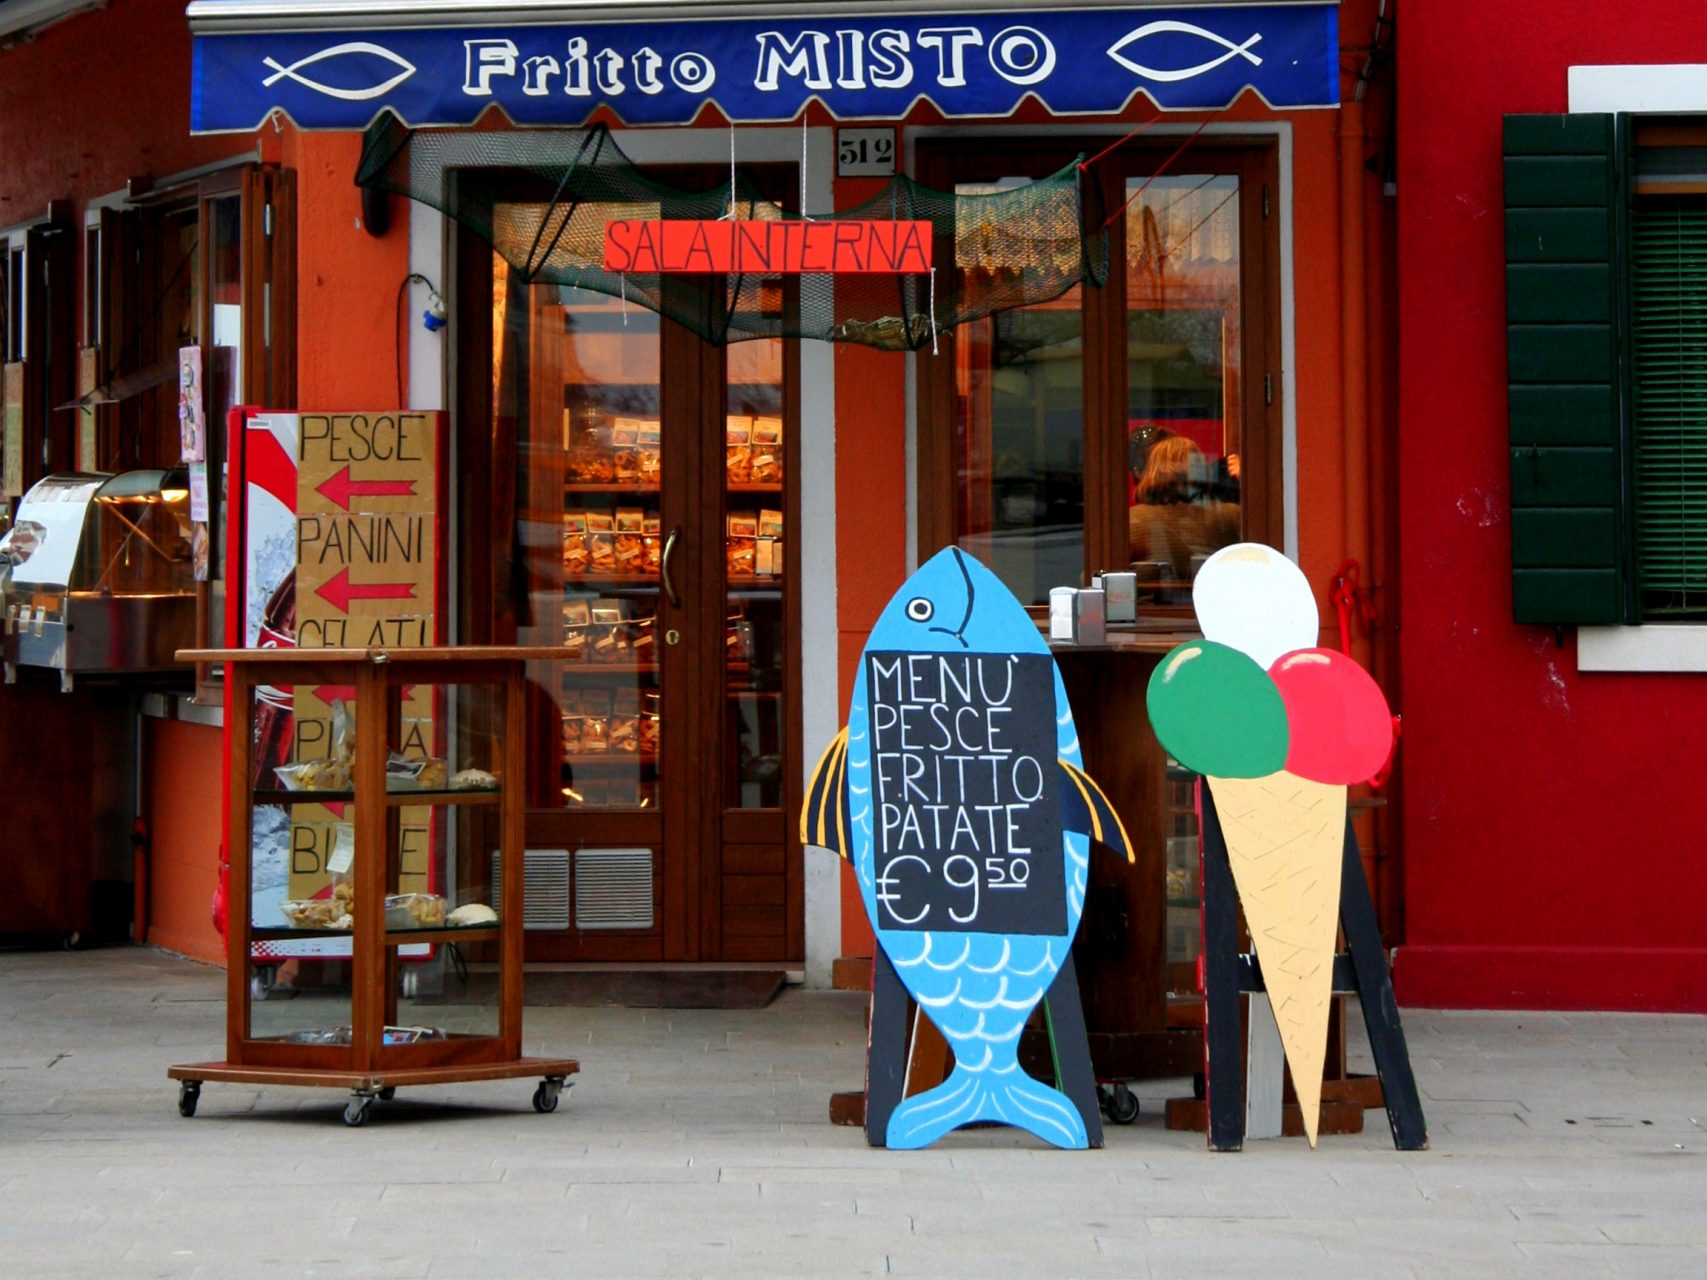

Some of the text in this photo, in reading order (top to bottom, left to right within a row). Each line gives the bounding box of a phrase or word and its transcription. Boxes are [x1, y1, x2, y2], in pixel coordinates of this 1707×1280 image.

[462, 25, 1057, 96] Fritto MISTO
[839, 139, 892, 165] 312
[605, 221, 928, 271] SALA INTERNA
[301, 415, 425, 461] PESCE
[298, 517, 422, 564] PANINI
[297, 719, 428, 761] PIA
[874, 703, 1013, 753] PESCE
[877, 753, 1044, 803] FRITTO
[881, 803, 1031, 854] PATATE
